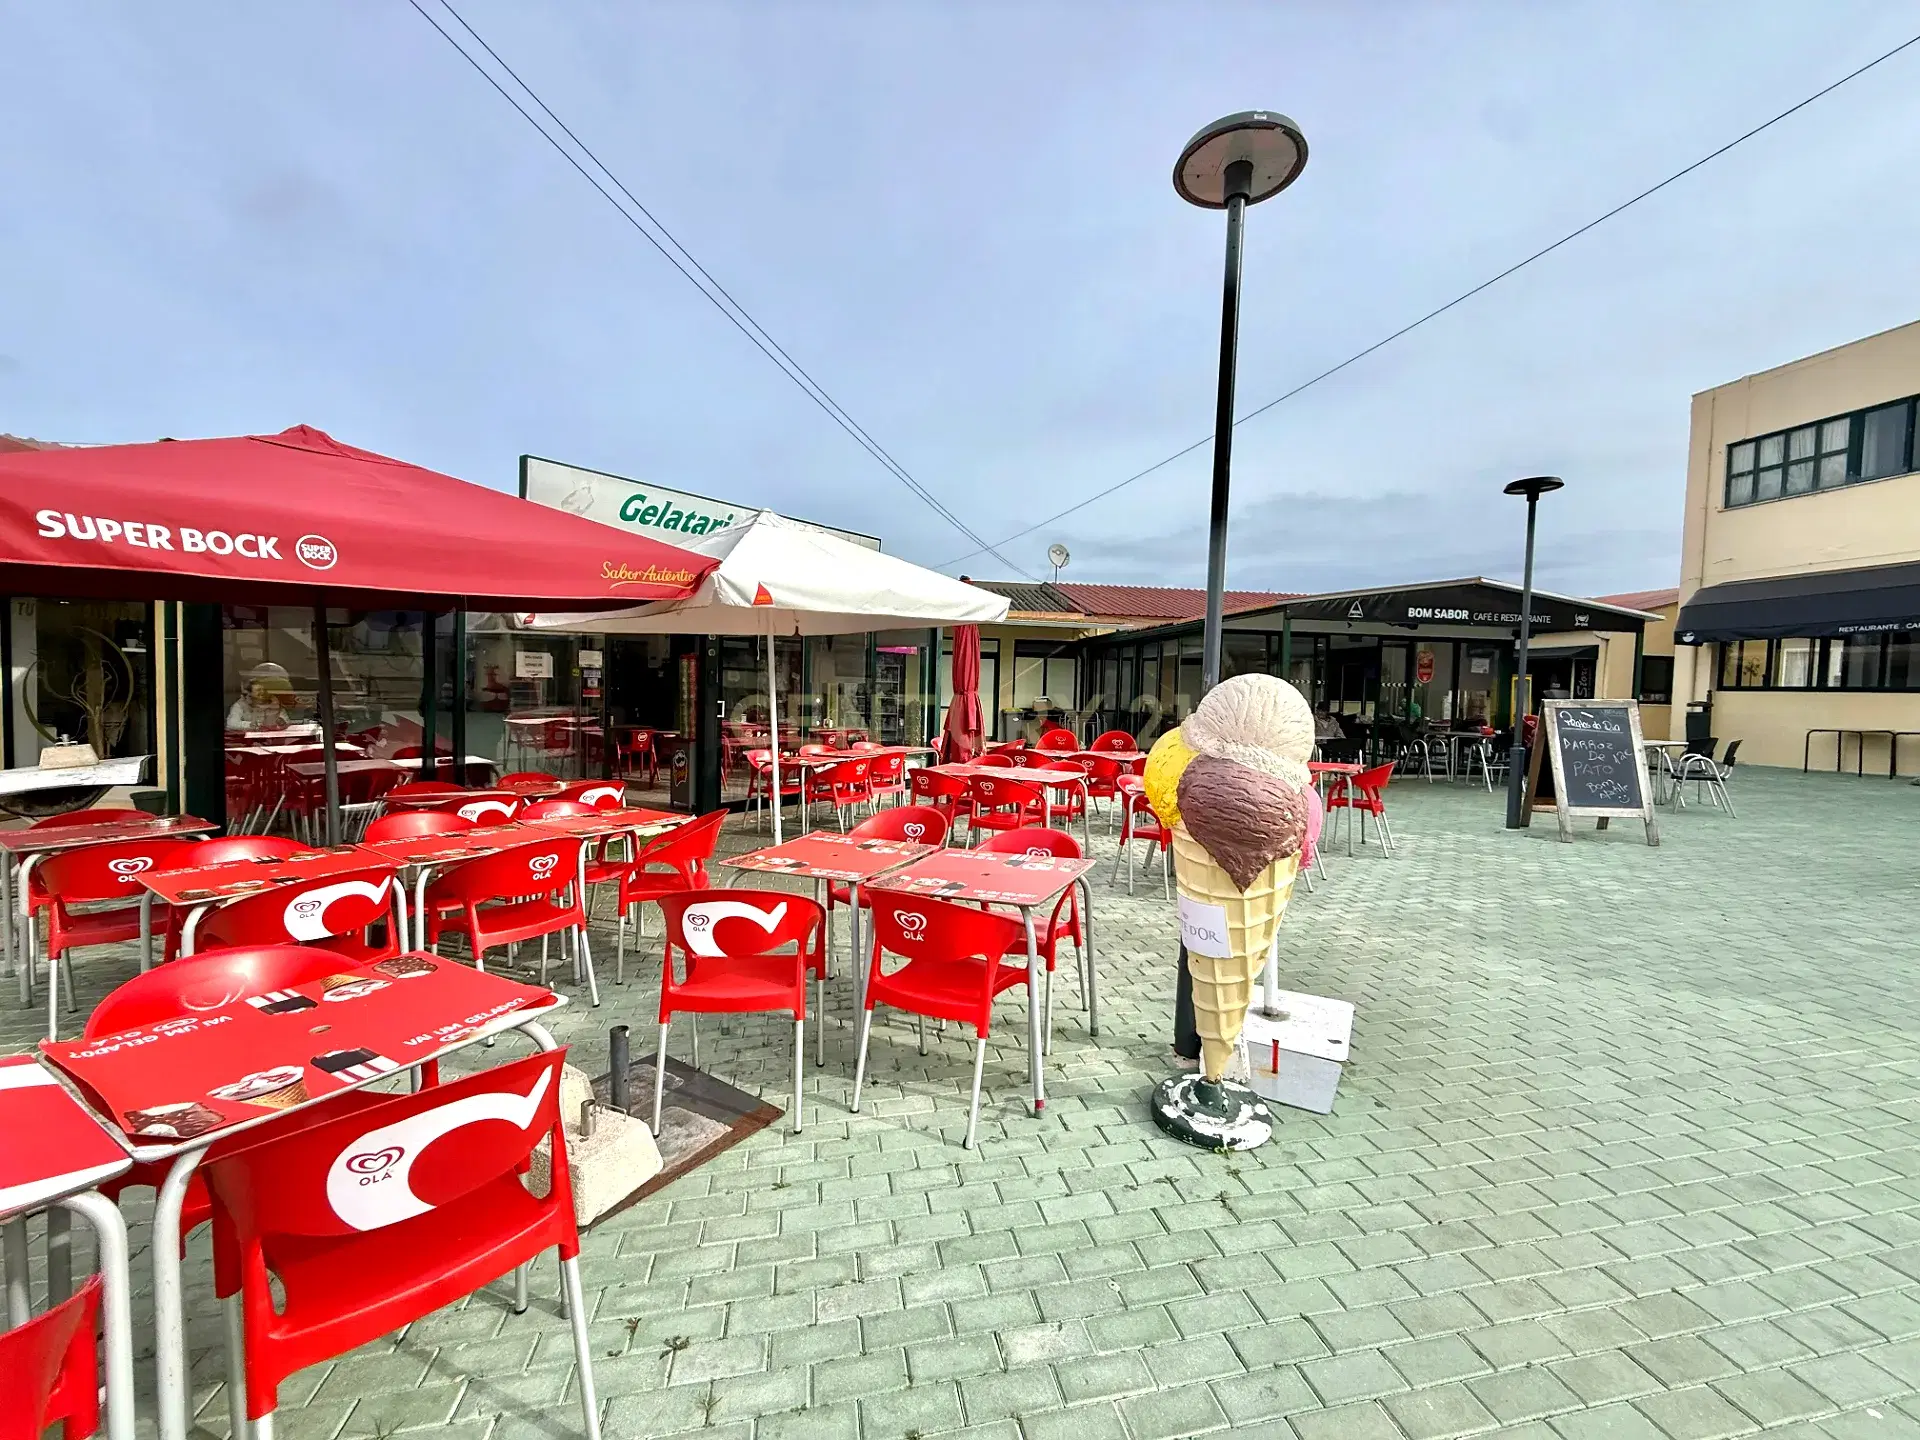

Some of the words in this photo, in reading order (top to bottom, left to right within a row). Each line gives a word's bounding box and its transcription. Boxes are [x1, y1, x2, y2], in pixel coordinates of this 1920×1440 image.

[619, 493, 735, 535] Gelatari
[35, 509, 175, 551] SUPER
[179, 526, 283, 560] BOCK
[301, 543, 331, 553] SUPER
[303, 550, 332, 561] BOCK
[600, 560, 641, 580] Sabor
[1407, 607, 1432, 618] BOM
[1433, 608, 1469, 620] SABOR
[1473, 611, 1492, 621] CAFÉ
[1493, 613, 1499, 622] E
[1500, 613, 1552, 624] RESTARANTE
[1838, 623, 1899, 633] RESTAURANTE
[1572, 760, 1614, 777] PATO
[117, 874, 136, 883] OL
[201, 1014, 234, 1028] VAI
[402, 1032, 434, 1047] VAI
[432, 1021, 464, 1036] UM
[464, 996, 527, 1025] GELADO?
[163, 1023, 199, 1038] UM
[68, 1033, 160, 1060] GELADO?
